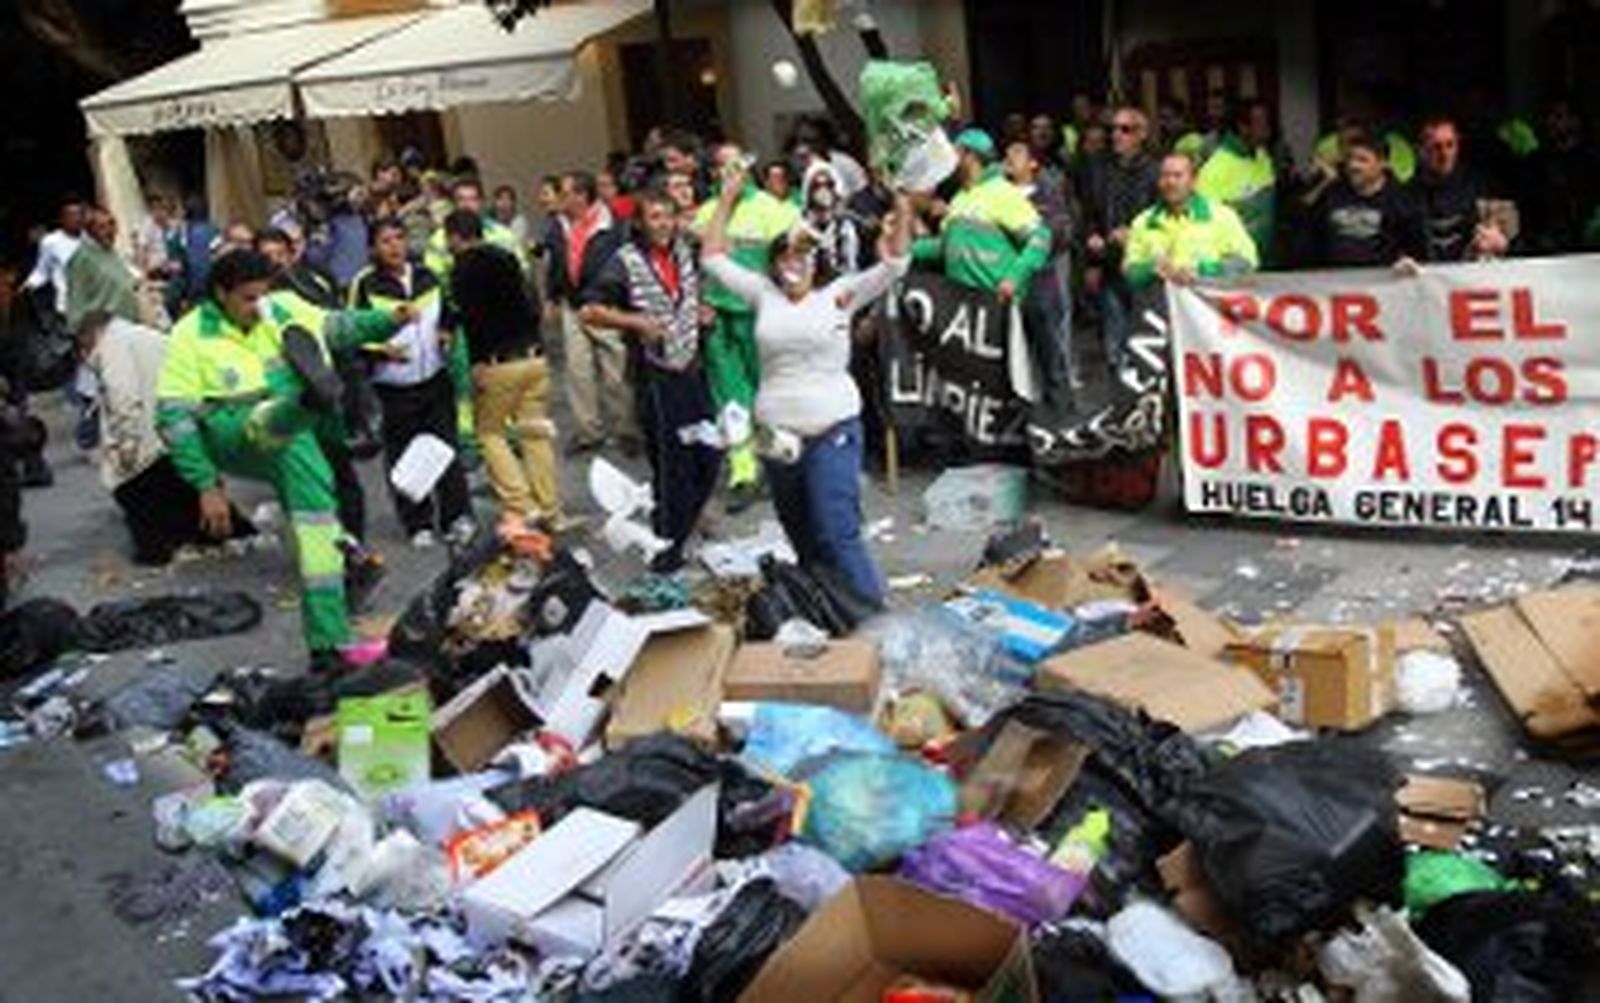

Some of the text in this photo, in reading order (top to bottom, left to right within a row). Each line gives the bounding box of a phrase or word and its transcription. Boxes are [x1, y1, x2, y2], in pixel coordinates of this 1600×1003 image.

[939, 303, 1003, 358] AL
[1216, 287, 1567, 344] POR EL
[1184, 352, 1569, 407] NO A LOS
[1202, 481, 1592, 529] HUELGA GENERAL 14
